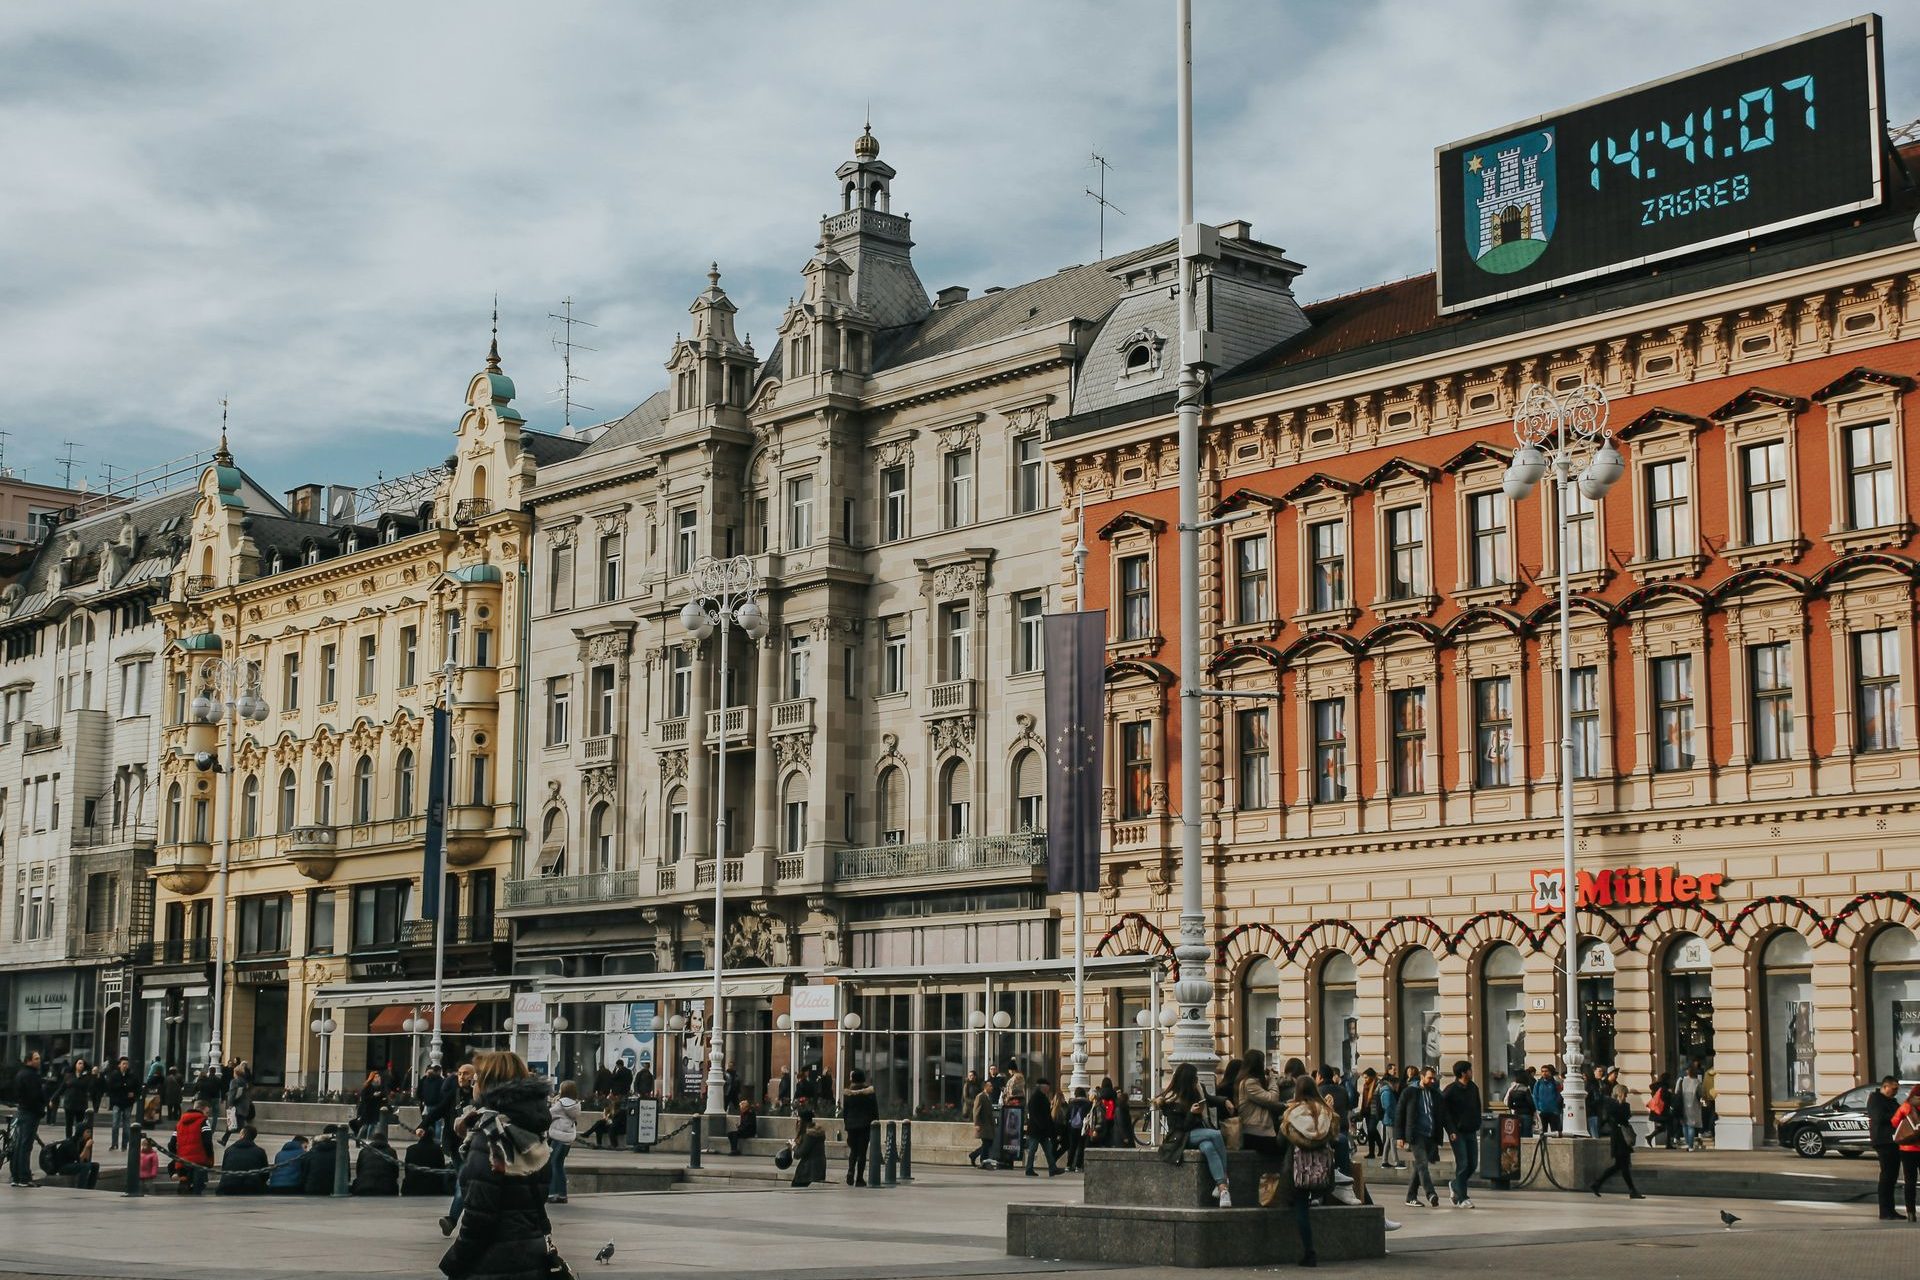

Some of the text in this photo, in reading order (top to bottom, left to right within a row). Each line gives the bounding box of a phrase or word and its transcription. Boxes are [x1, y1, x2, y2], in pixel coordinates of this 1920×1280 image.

[1590, 74, 1816, 191] 14:41:07
[1641, 174, 1749, 226] ZAGREB
[1575, 866, 1724, 907] Müller
[25, 994, 67, 1005] MALA KAVANA
[1828, 1121, 1861, 1130] KLEMM
